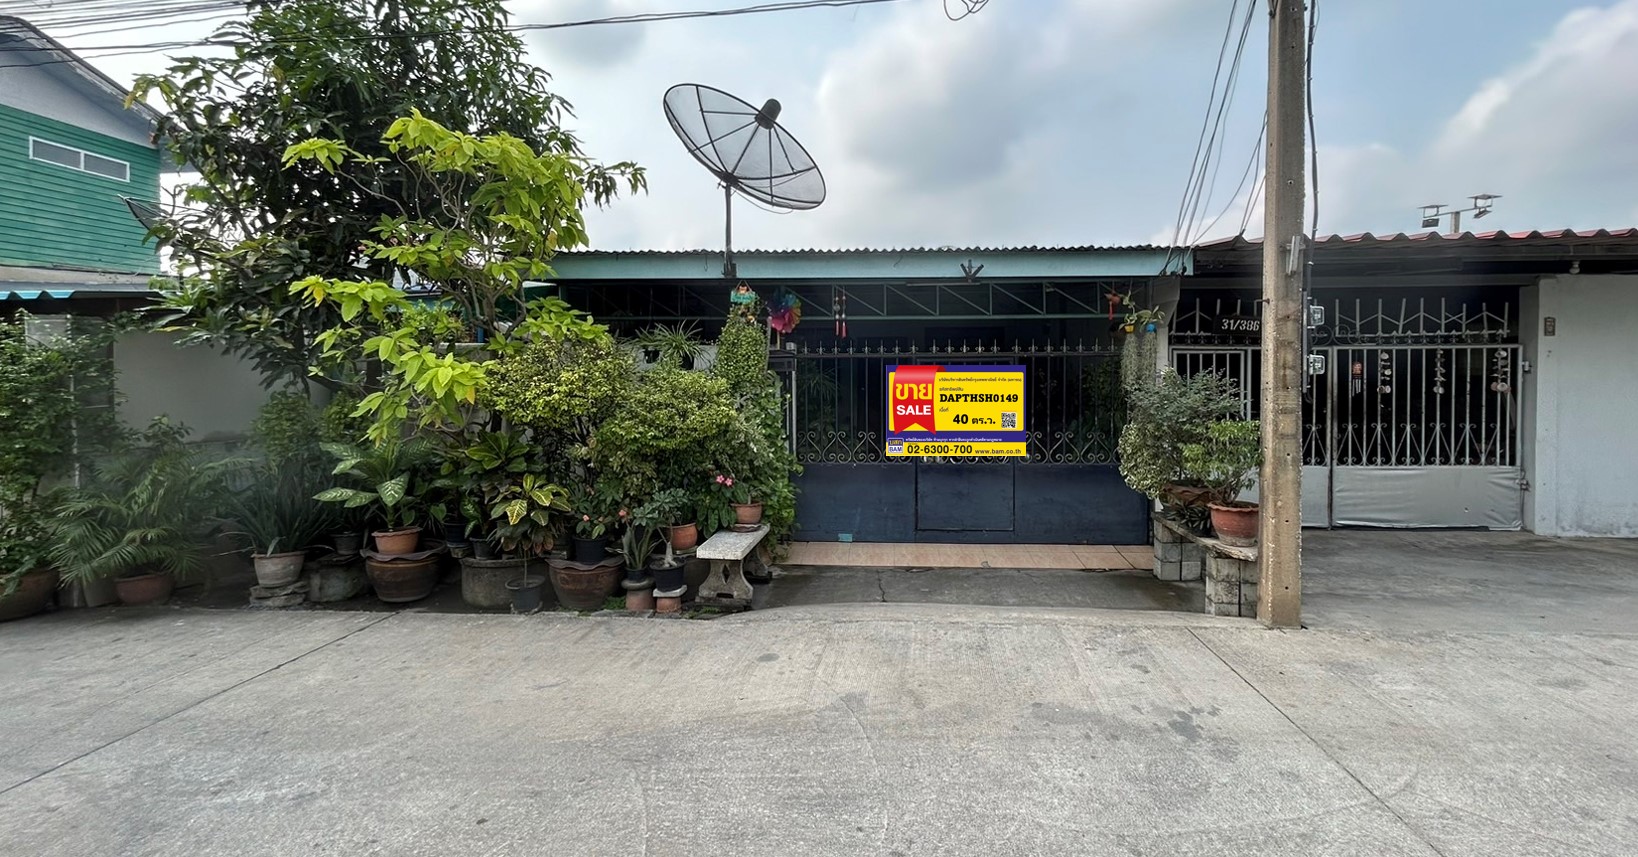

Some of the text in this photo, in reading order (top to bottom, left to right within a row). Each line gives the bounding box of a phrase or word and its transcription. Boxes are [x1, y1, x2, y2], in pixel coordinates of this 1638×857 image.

[1221, 318, 1260, 331] 31/386
[896, 383, 933, 400] ขาย
[940, 394, 1018, 402] DAPTHSH0149
[896, 405, 932, 415] SALE
[953, 414, 996, 425] 40 ตร.ว.
[907, 445, 973, 454] 02-6300-700
